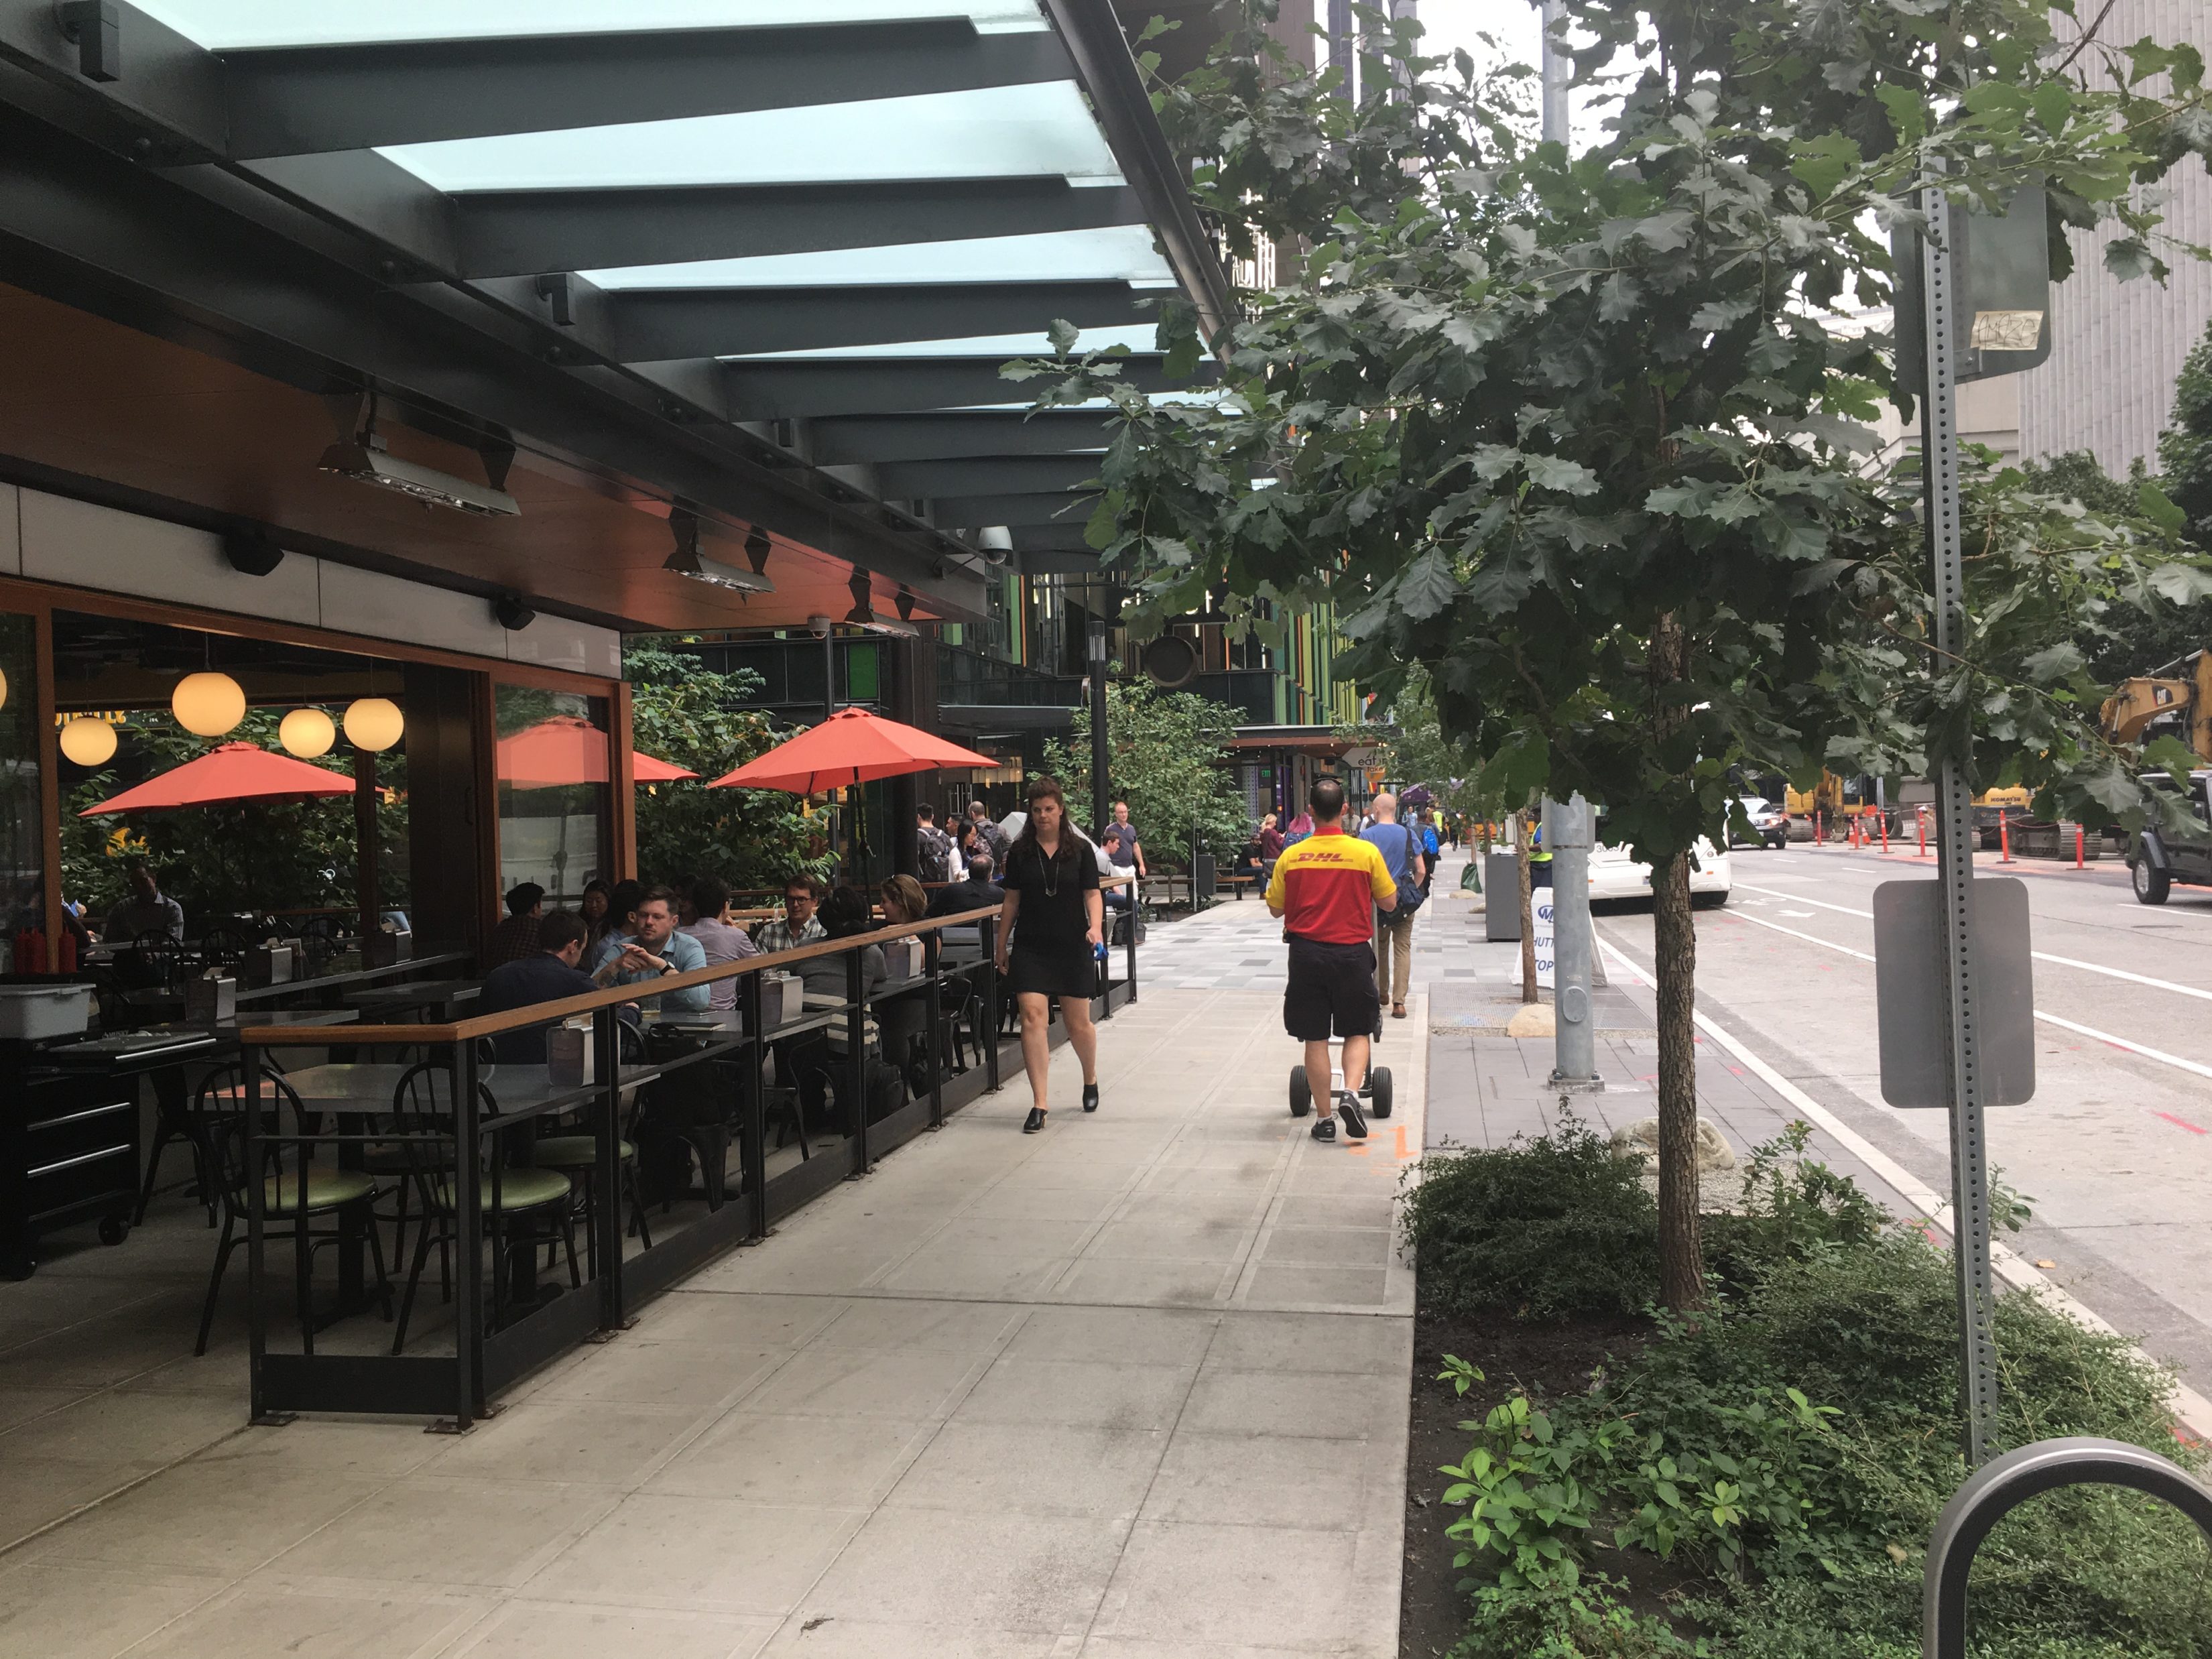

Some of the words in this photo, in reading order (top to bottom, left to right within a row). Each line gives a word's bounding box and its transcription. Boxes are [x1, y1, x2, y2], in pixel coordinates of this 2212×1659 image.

[2156, 688, 2166, 704] CAT
[1358, 755, 1377, 766] eat
[1297, 853, 1345, 862] DHL
[1534, 936, 1554, 948] HUTT
[1535, 959, 1554, 971] OP
